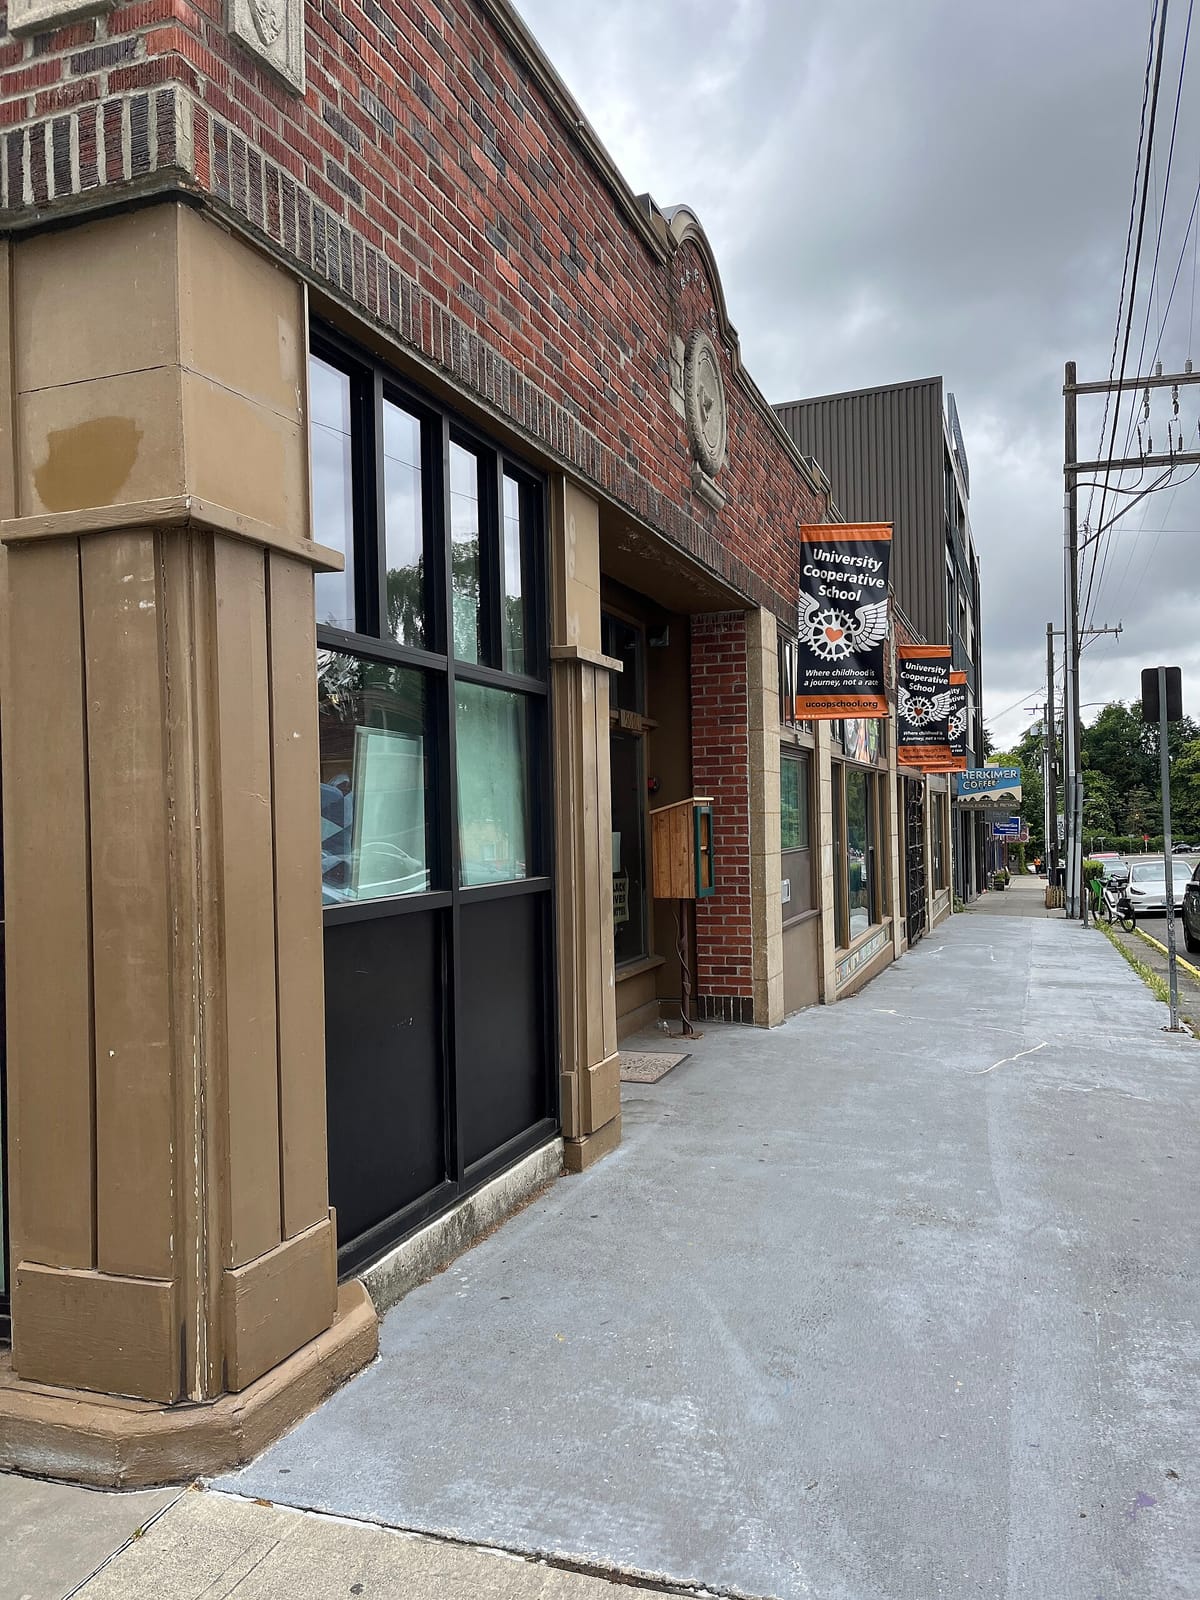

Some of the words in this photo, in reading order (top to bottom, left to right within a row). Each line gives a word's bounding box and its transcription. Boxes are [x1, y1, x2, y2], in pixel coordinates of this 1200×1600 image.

[813, 548, 883, 572] University
[803, 564, 885, 588] Cooperative
[818, 584, 862, 601] School
[805, 669, 831, 677] Where
[831, 668, 869, 677] childhood
[905, 662, 947, 675] University
[809, 679, 841, 688] journey,
[900, 671, 949, 685] Cooperative
[909, 682, 936, 693] School
[805, 700, 878, 708] ucoopschool.org
[961, 770, 1017, 780] HERKIMER
[963, 780, 997, 790] COFFEE
